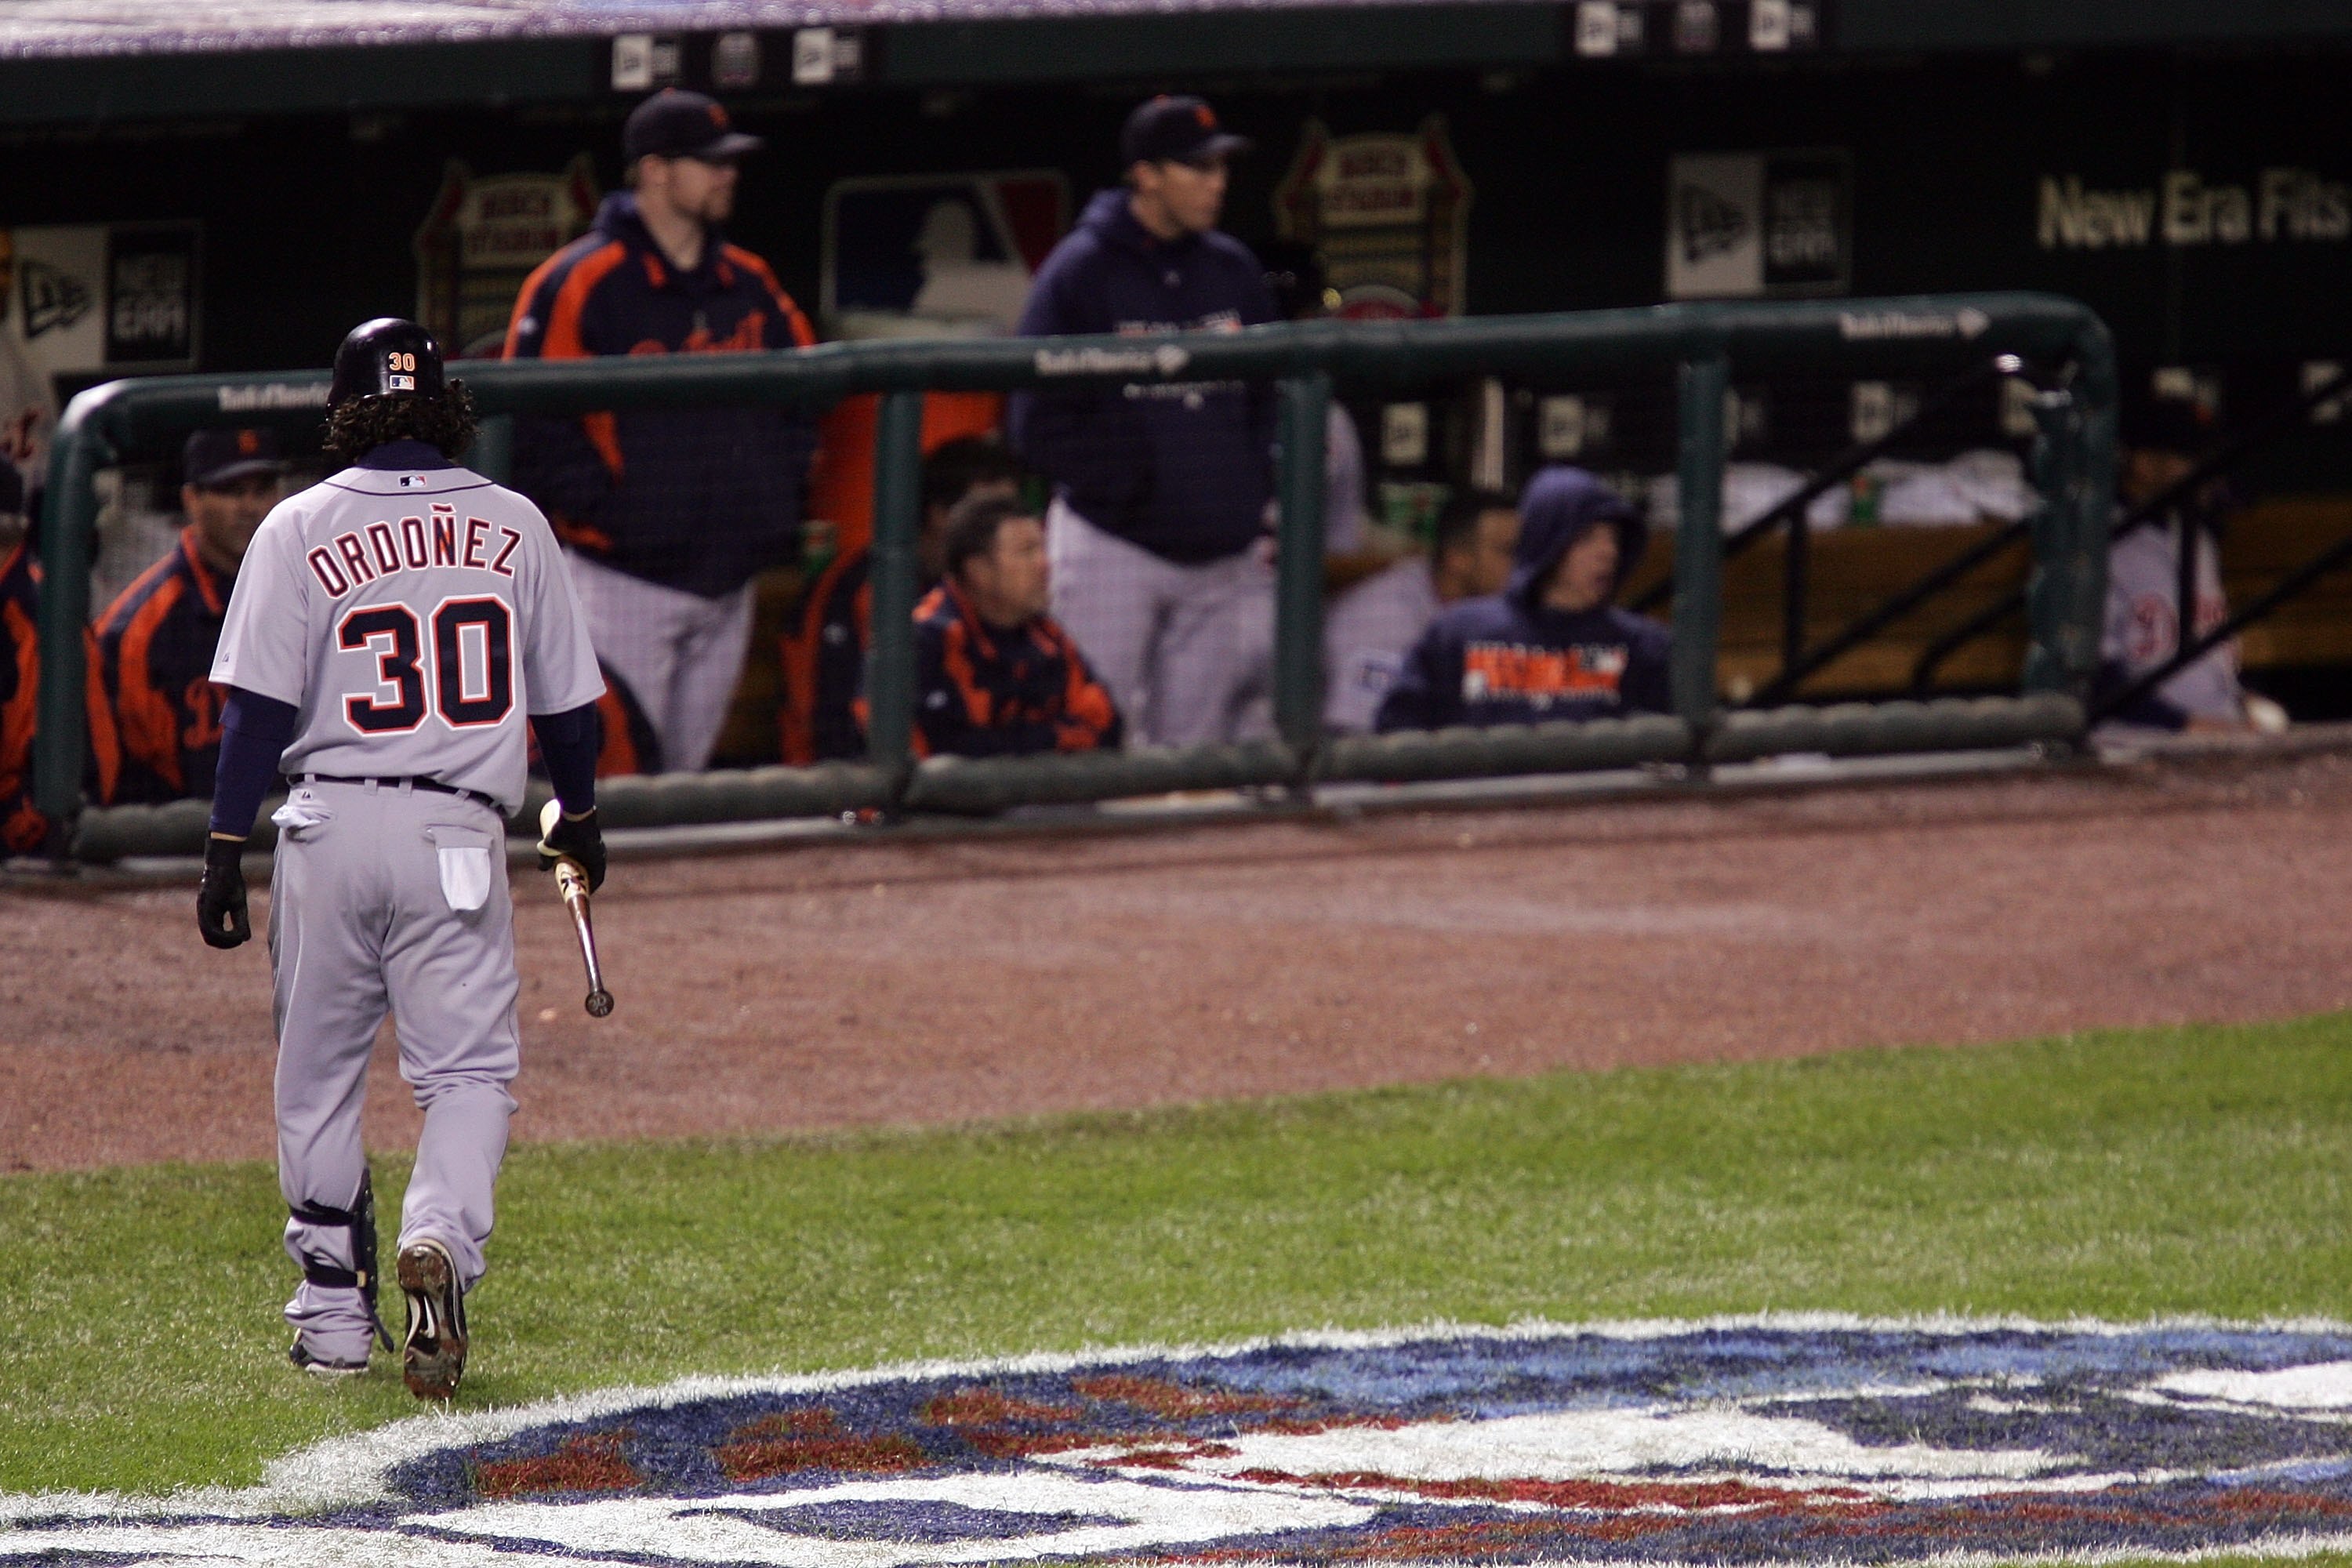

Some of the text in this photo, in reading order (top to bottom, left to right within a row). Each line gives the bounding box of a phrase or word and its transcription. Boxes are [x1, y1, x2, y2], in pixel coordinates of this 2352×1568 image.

[2038, 173, 2154, 249] New
[2162, 168, 2252, 247] Era
[388, 352, 416, 372] 30
[307, 503, 523, 599] ORDOÑEZ
[335, 593, 515, 737] 30
